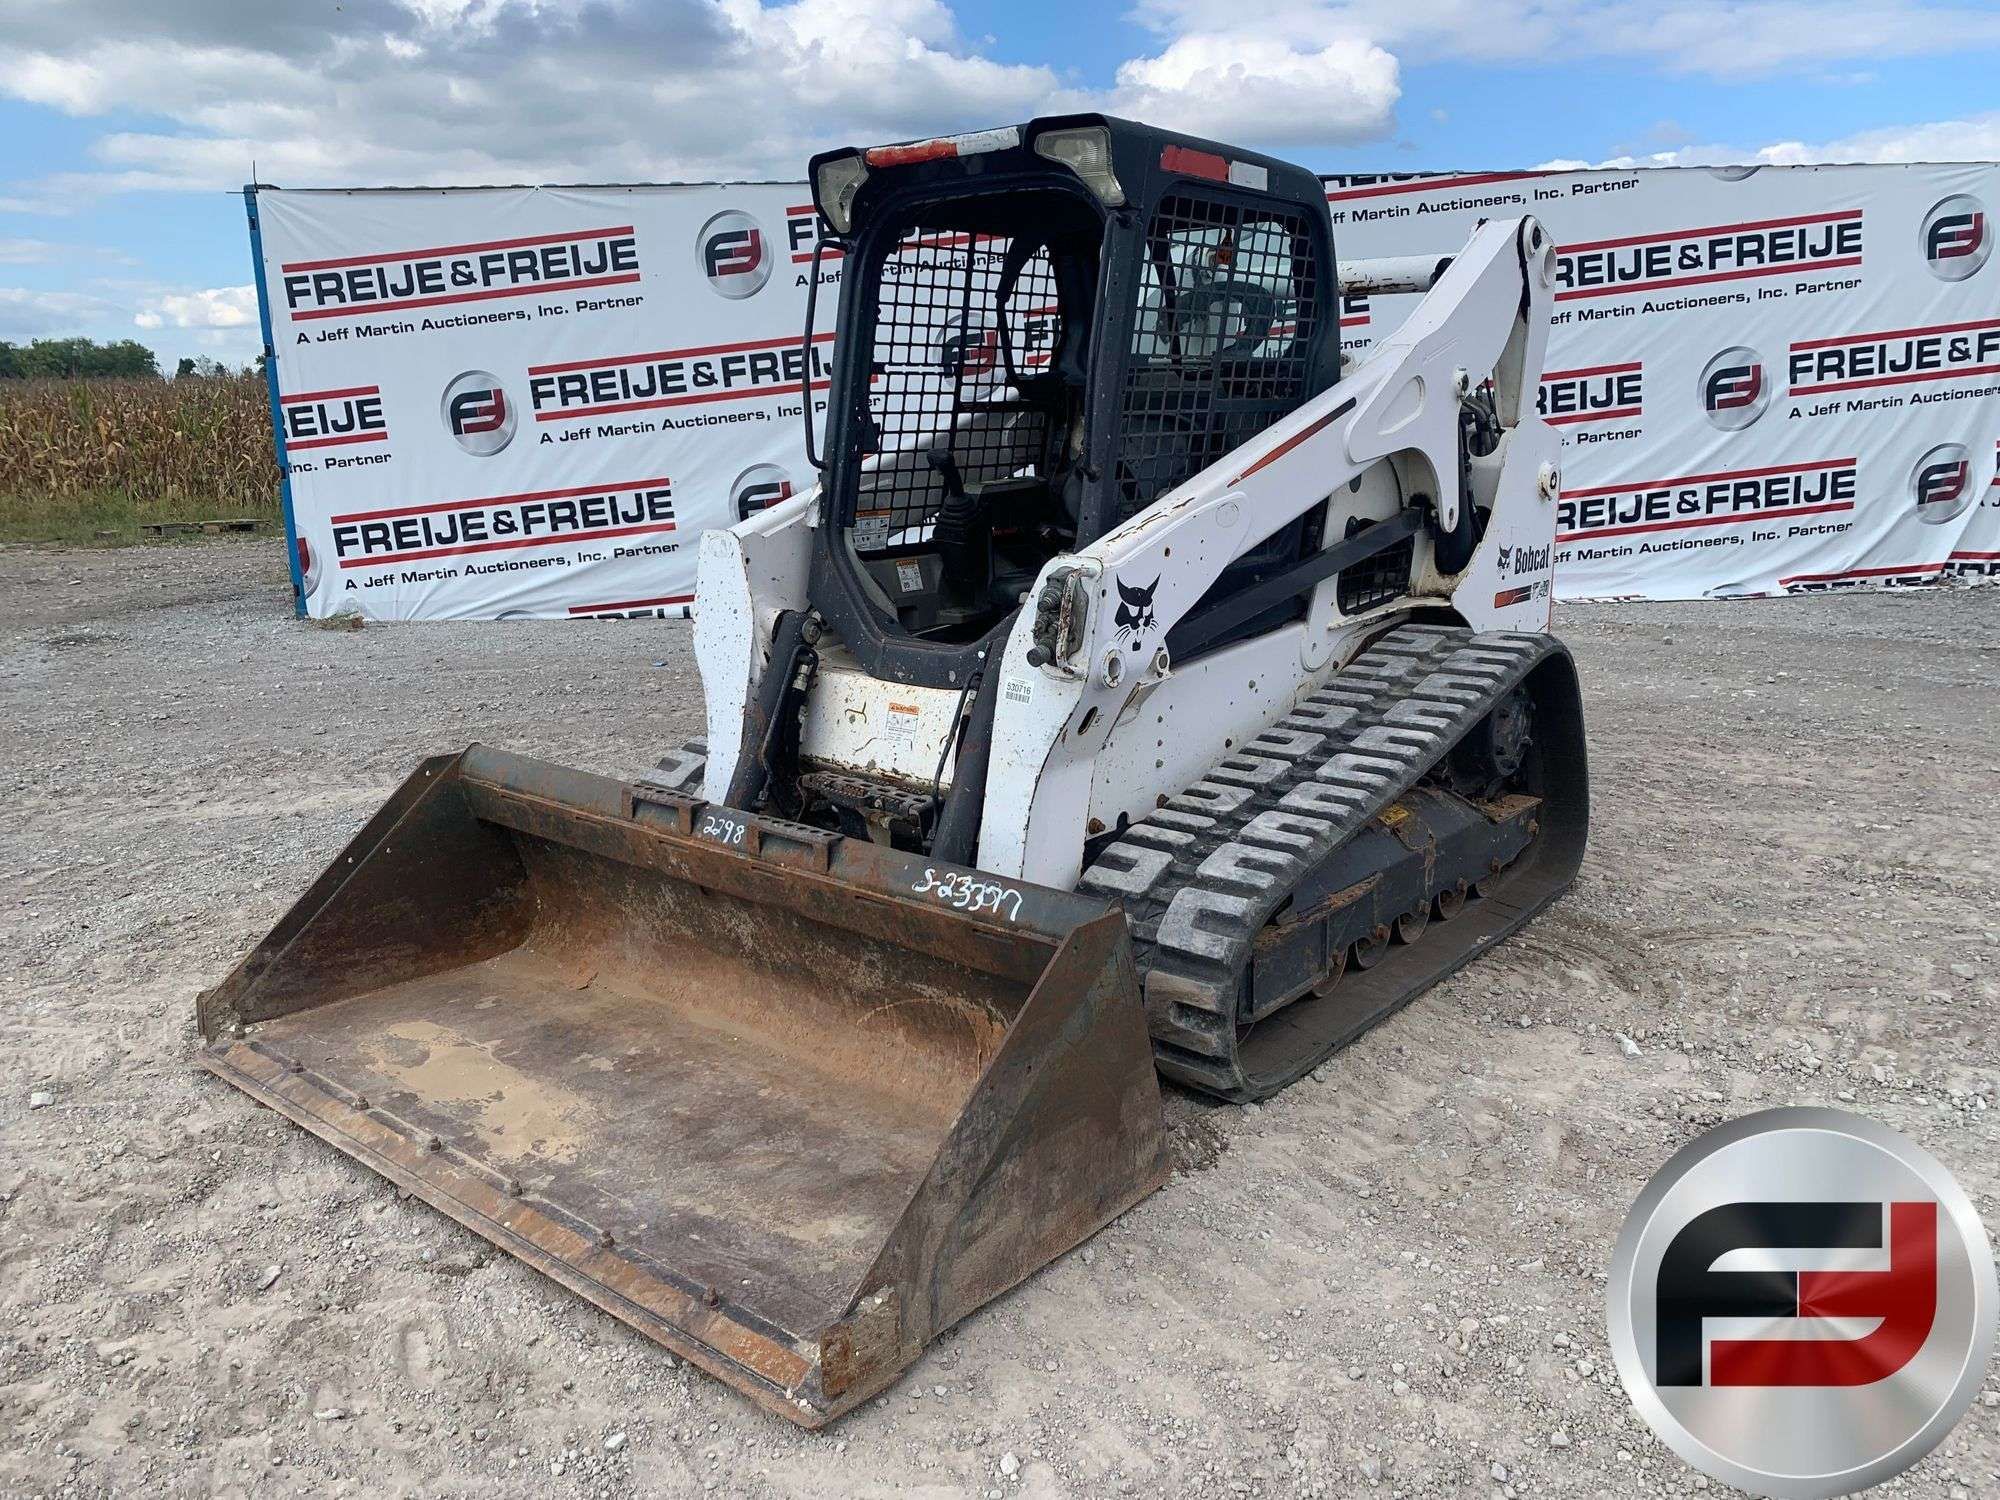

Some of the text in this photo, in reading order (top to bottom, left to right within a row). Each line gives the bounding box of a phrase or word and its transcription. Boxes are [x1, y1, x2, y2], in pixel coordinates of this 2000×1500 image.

[1352, 205, 1410, 223] Martin
[1416, 192, 1527, 215] Auctioneers,
[1534, 188, 1565, 201] Inc.
[1572, 178, 1640, 196] Partner
[1578, 304, 1635, 322] Martin
[1641, 291, 1751, 314] Auctioneers,
[1757, 287, 1788, 300] Inc.
[1795, 277, 1863, 295] Partner
[296, 295, 644, 345] A Jeff Martin Auctioneers, Inc. Partner
[540, 433, 554, 445] A
[559, 428, 591, 442] Jeff
[597, 421, 655, 438] Martin
[662, 409, 772, 431] Auctioneers,
[777, 405, 803, 418] Inc
[1789, 407, 1802, 419] A
[1808, 402, 1841, 417] Jeff
[1847, 395, 1903, 412] Martin
[1577, 429, 1643, 445] Partner
[325, 453, 392, 470] Partner
[1514, 543, 1550, 575] Bobcat
[1577, 545, 1633, 561] Martin
[1639, 535, 1745, 555] Auctioneers,
[1752, 530, 1781, 542] Inc.
[1788, 521, 1853, 538] Partner
[345, 542, 680, 591] A Jeff Martin Auctioneers, Inc. Partner
[703, 815, 745, 844] 2298
